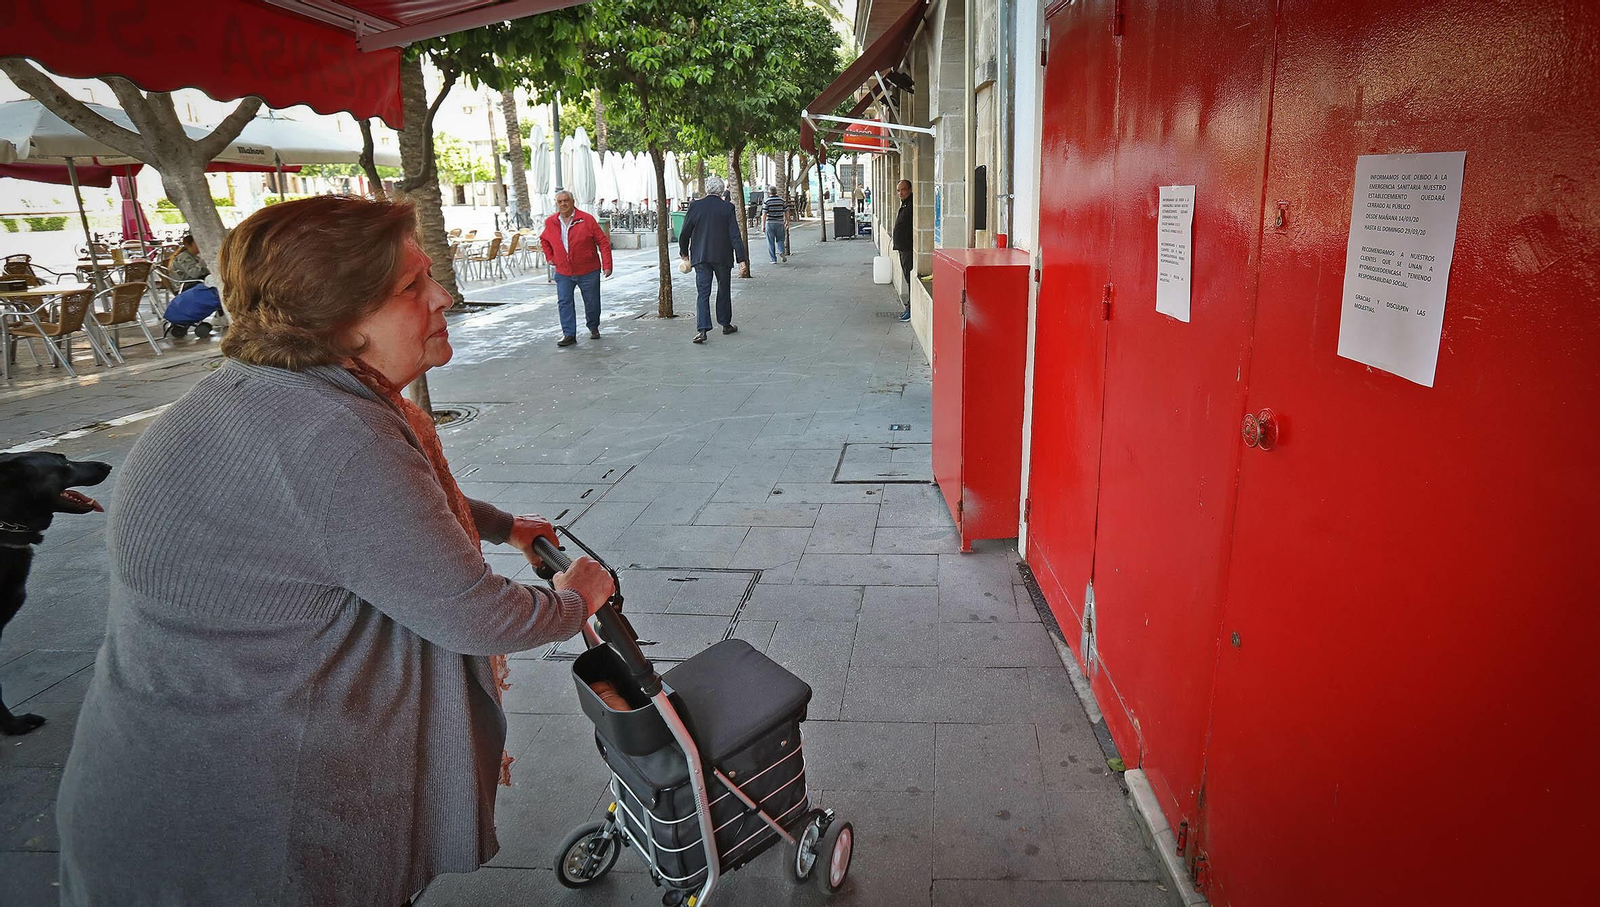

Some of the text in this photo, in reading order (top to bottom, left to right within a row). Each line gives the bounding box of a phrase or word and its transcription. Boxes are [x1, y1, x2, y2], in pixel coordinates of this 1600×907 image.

[237, 146, 265, 155] Mahou
[1362, 246, 1395, 256] RECOMENDAMOS
[1410, 253, 1435, 262] NUESTROS
[1358, 273, 1408, 288] RESPONSABILIDAD SOCIAL.
[1408, 273, 1431, 282] TENIENDO
[1355, 294, 1371, 302] GRACIAS
[1386, 302, 1409, 312] DISCULPEN
